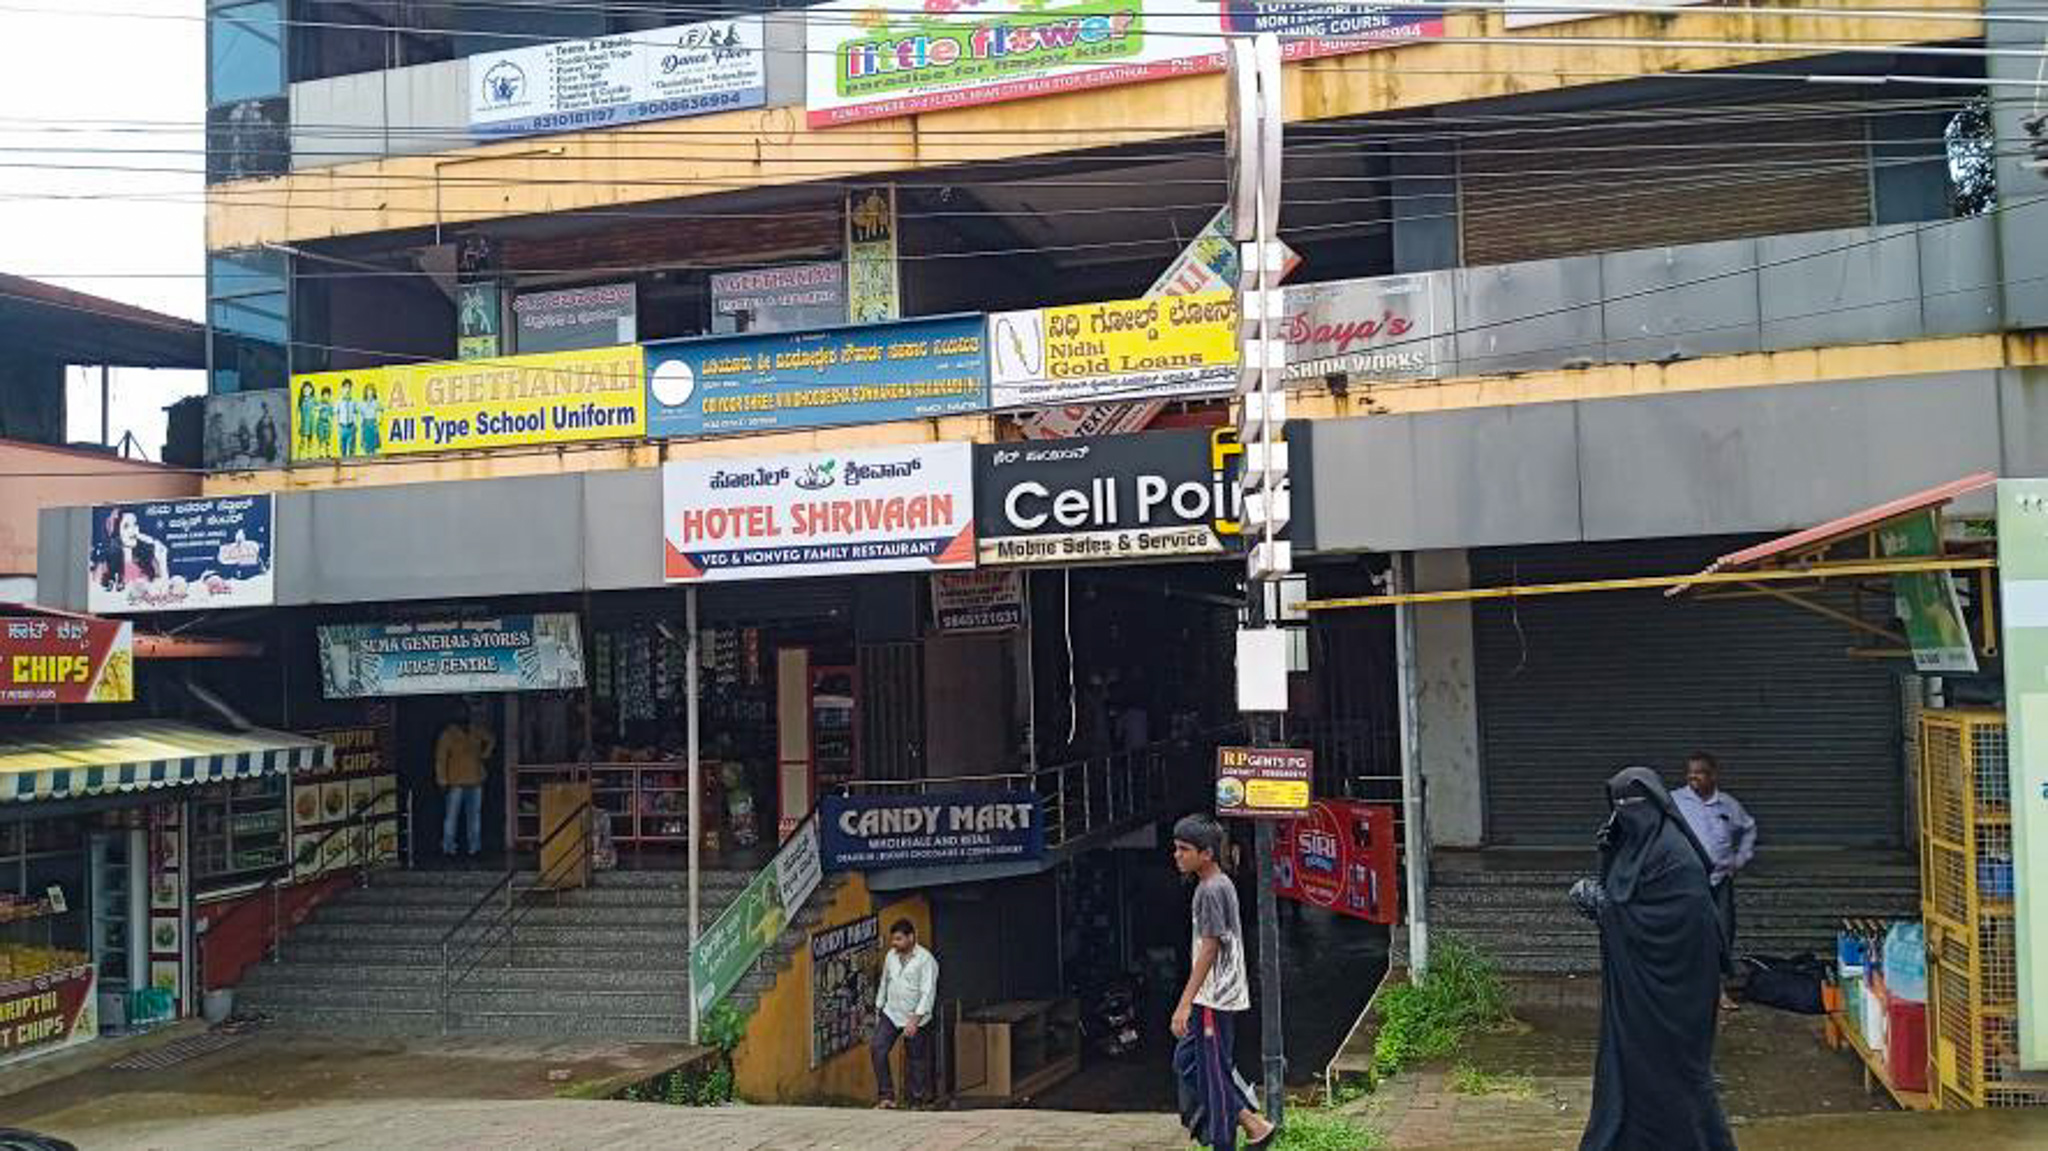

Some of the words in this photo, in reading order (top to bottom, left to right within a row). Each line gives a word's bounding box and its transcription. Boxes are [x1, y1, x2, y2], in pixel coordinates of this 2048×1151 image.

[1331, 16, 1390, 33] COURSE
[847, 35, 961, 78] little
[955, 64, 986, 77] for
[1049, 313, 1081, 340] ನಿಧಿ
[1049, 340, 1106, 360] Nidhi
[1352, 352, 1425, 373] WORKS
[1049, 358, 1111, 377] Gold
[1120, 352, 1204, 371] Loans
[425, 359, 637, 407] GEETHANJALI
[390, 416, 415, 442] All
[421, 415, 470, 445] Type
[475, 406, 545, 438] School
[553, 402, 636, 431] Uniform
[709, 465, 789, 490] ಹೋಟೆಲ್
[1004, 476, 1118, 530] Cell
[683, 503, 782, 544] HOTEL
[790, 492, 954, 539] SHRIVAAN
[701, 552, 730, 567] VEG
[731, 551, 743, 566] &
[744, 548, 801, 566] NONVEG
[803, 546, 849, 562] FAMILY
[851, 541, 938, 560] RESTAURANT
[997, 539, 1057, 559] Mobile
[1061, 535, 1112, 555] Sales
[1117, 533, 1132, 551] &
[1138, 531, 1208, 550] Service
[402, 632, 470, 651] GENERAL
[472, 629, 532, 648] STORES
[13, 655, 89, 683] CHIPS
[441, 655, 498, 673] CENTRE
[1287, 757, 1308, 769] PG
[838, 805, 942, 838] CANDY
[949, 803, 1034, 832] MART
[932, 835, 959, 848] AND
[1299, 830, 1337, 858] SIRI
[17, 1013, 65, 1044] CHIPS
